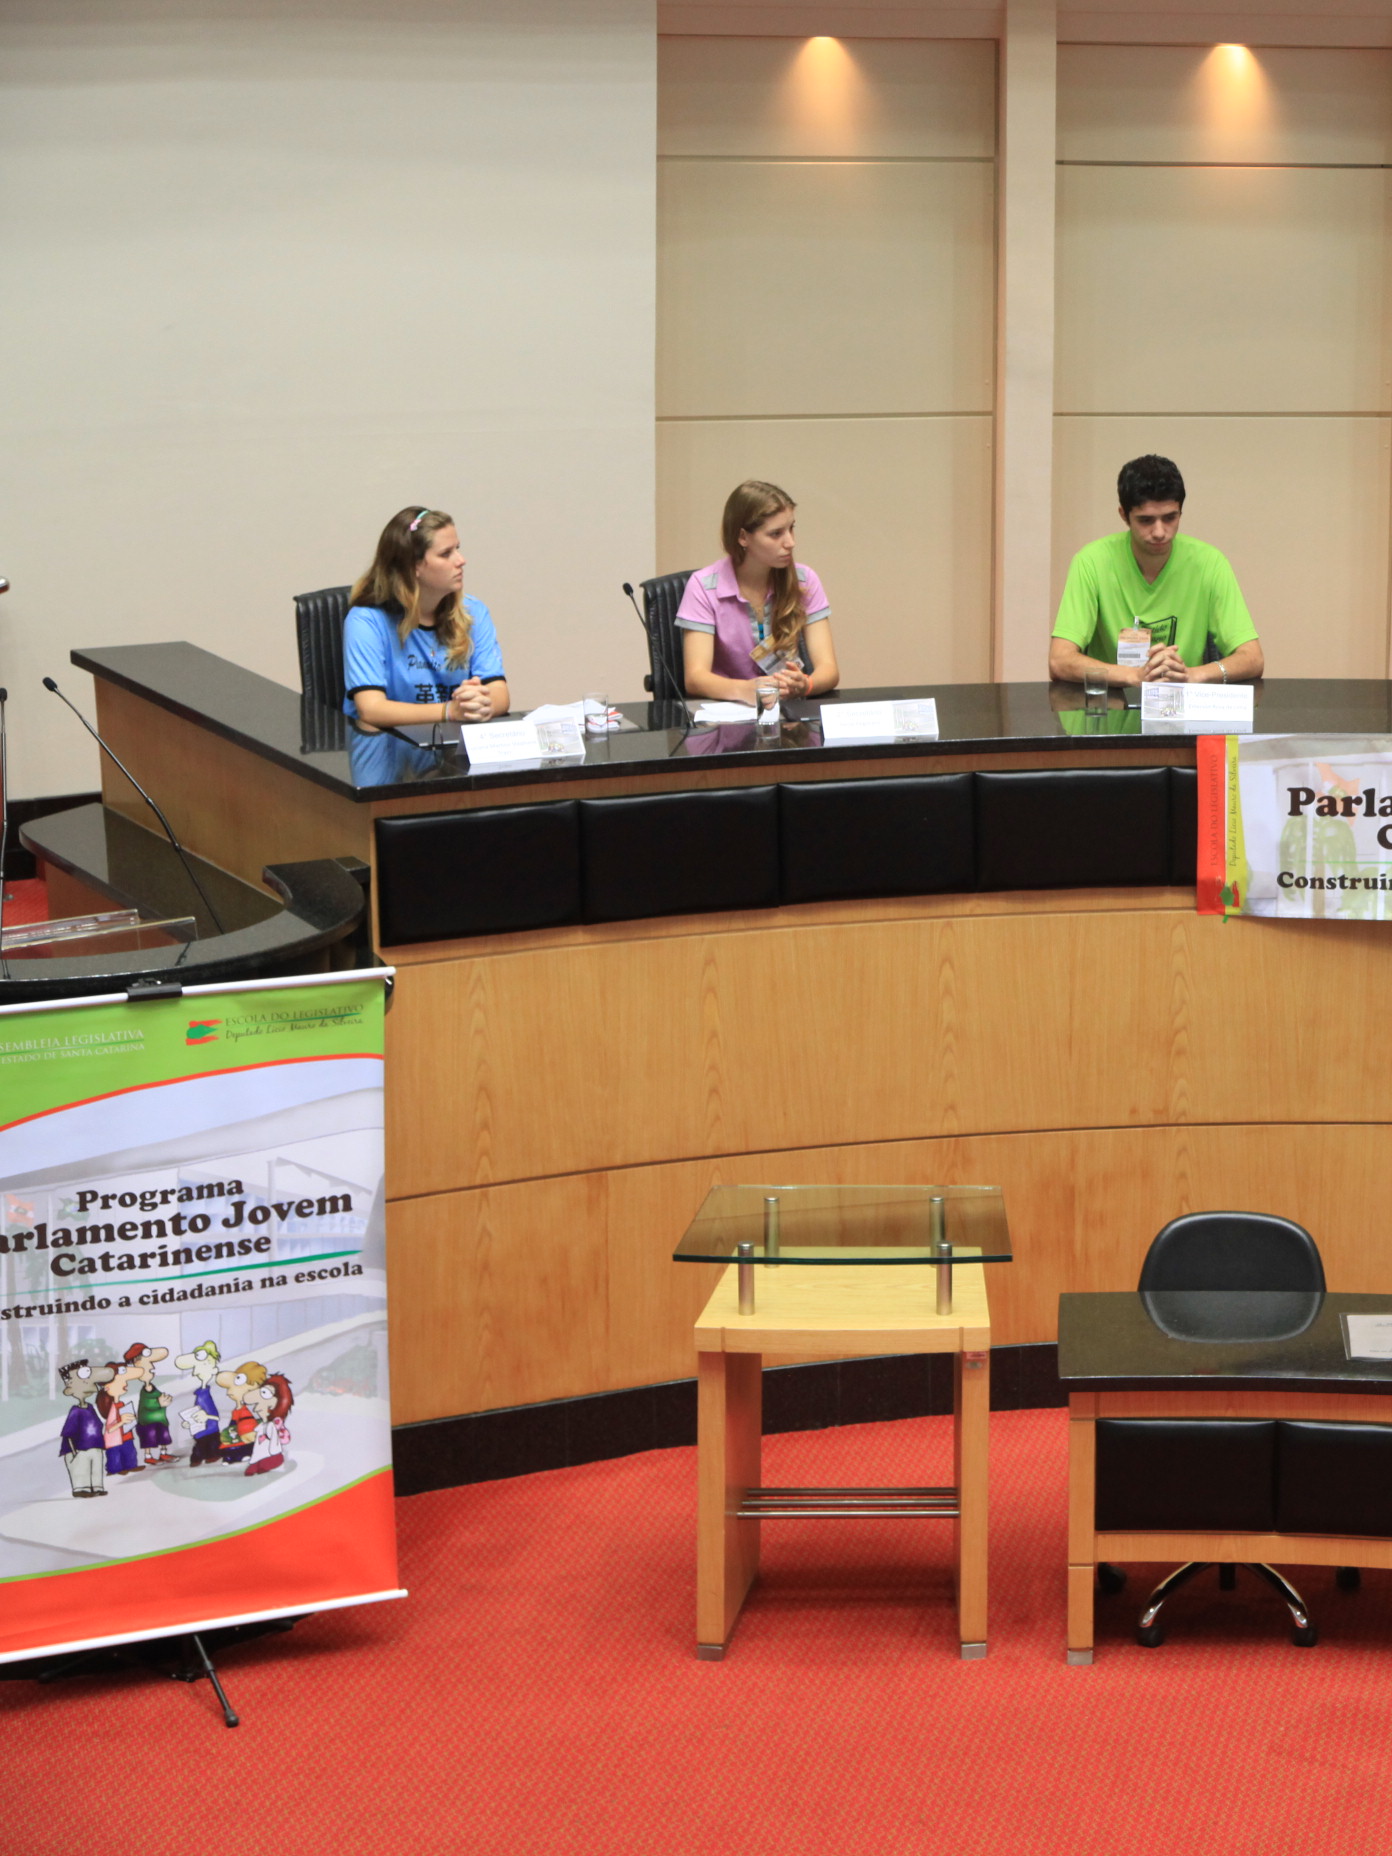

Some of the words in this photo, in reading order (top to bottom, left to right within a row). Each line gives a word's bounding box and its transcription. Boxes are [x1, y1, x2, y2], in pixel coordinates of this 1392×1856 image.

[225, 1013, 267, 1027] ESCOLA
[271, 1012, 289, 1021] DO
[293, 1004, 364, 1020] LEGISLATIVO
[1, 1053, 41, 1065] ESTADO
[44, 1052, 57, 1060] DE
[60, 1049, 93, 1059] SANTA
[95, 1043, 145, 1056] CATARINA
[65, 1029, 144, 1046] LEGISLATIVA
[76, 1179, 244, 1213] Programa
[222, 1192, 353, 1229] Jovem
[50, 1235, 272, 1278] Catarinense
[1, 1288, 111, 1320] struindo
[118, 1292, 132, 1307] a
[138, 1277, 254, 1305] cidadania
[260, 1273, 288, 1289] na
[294, 1261, 363, 1284] escola
